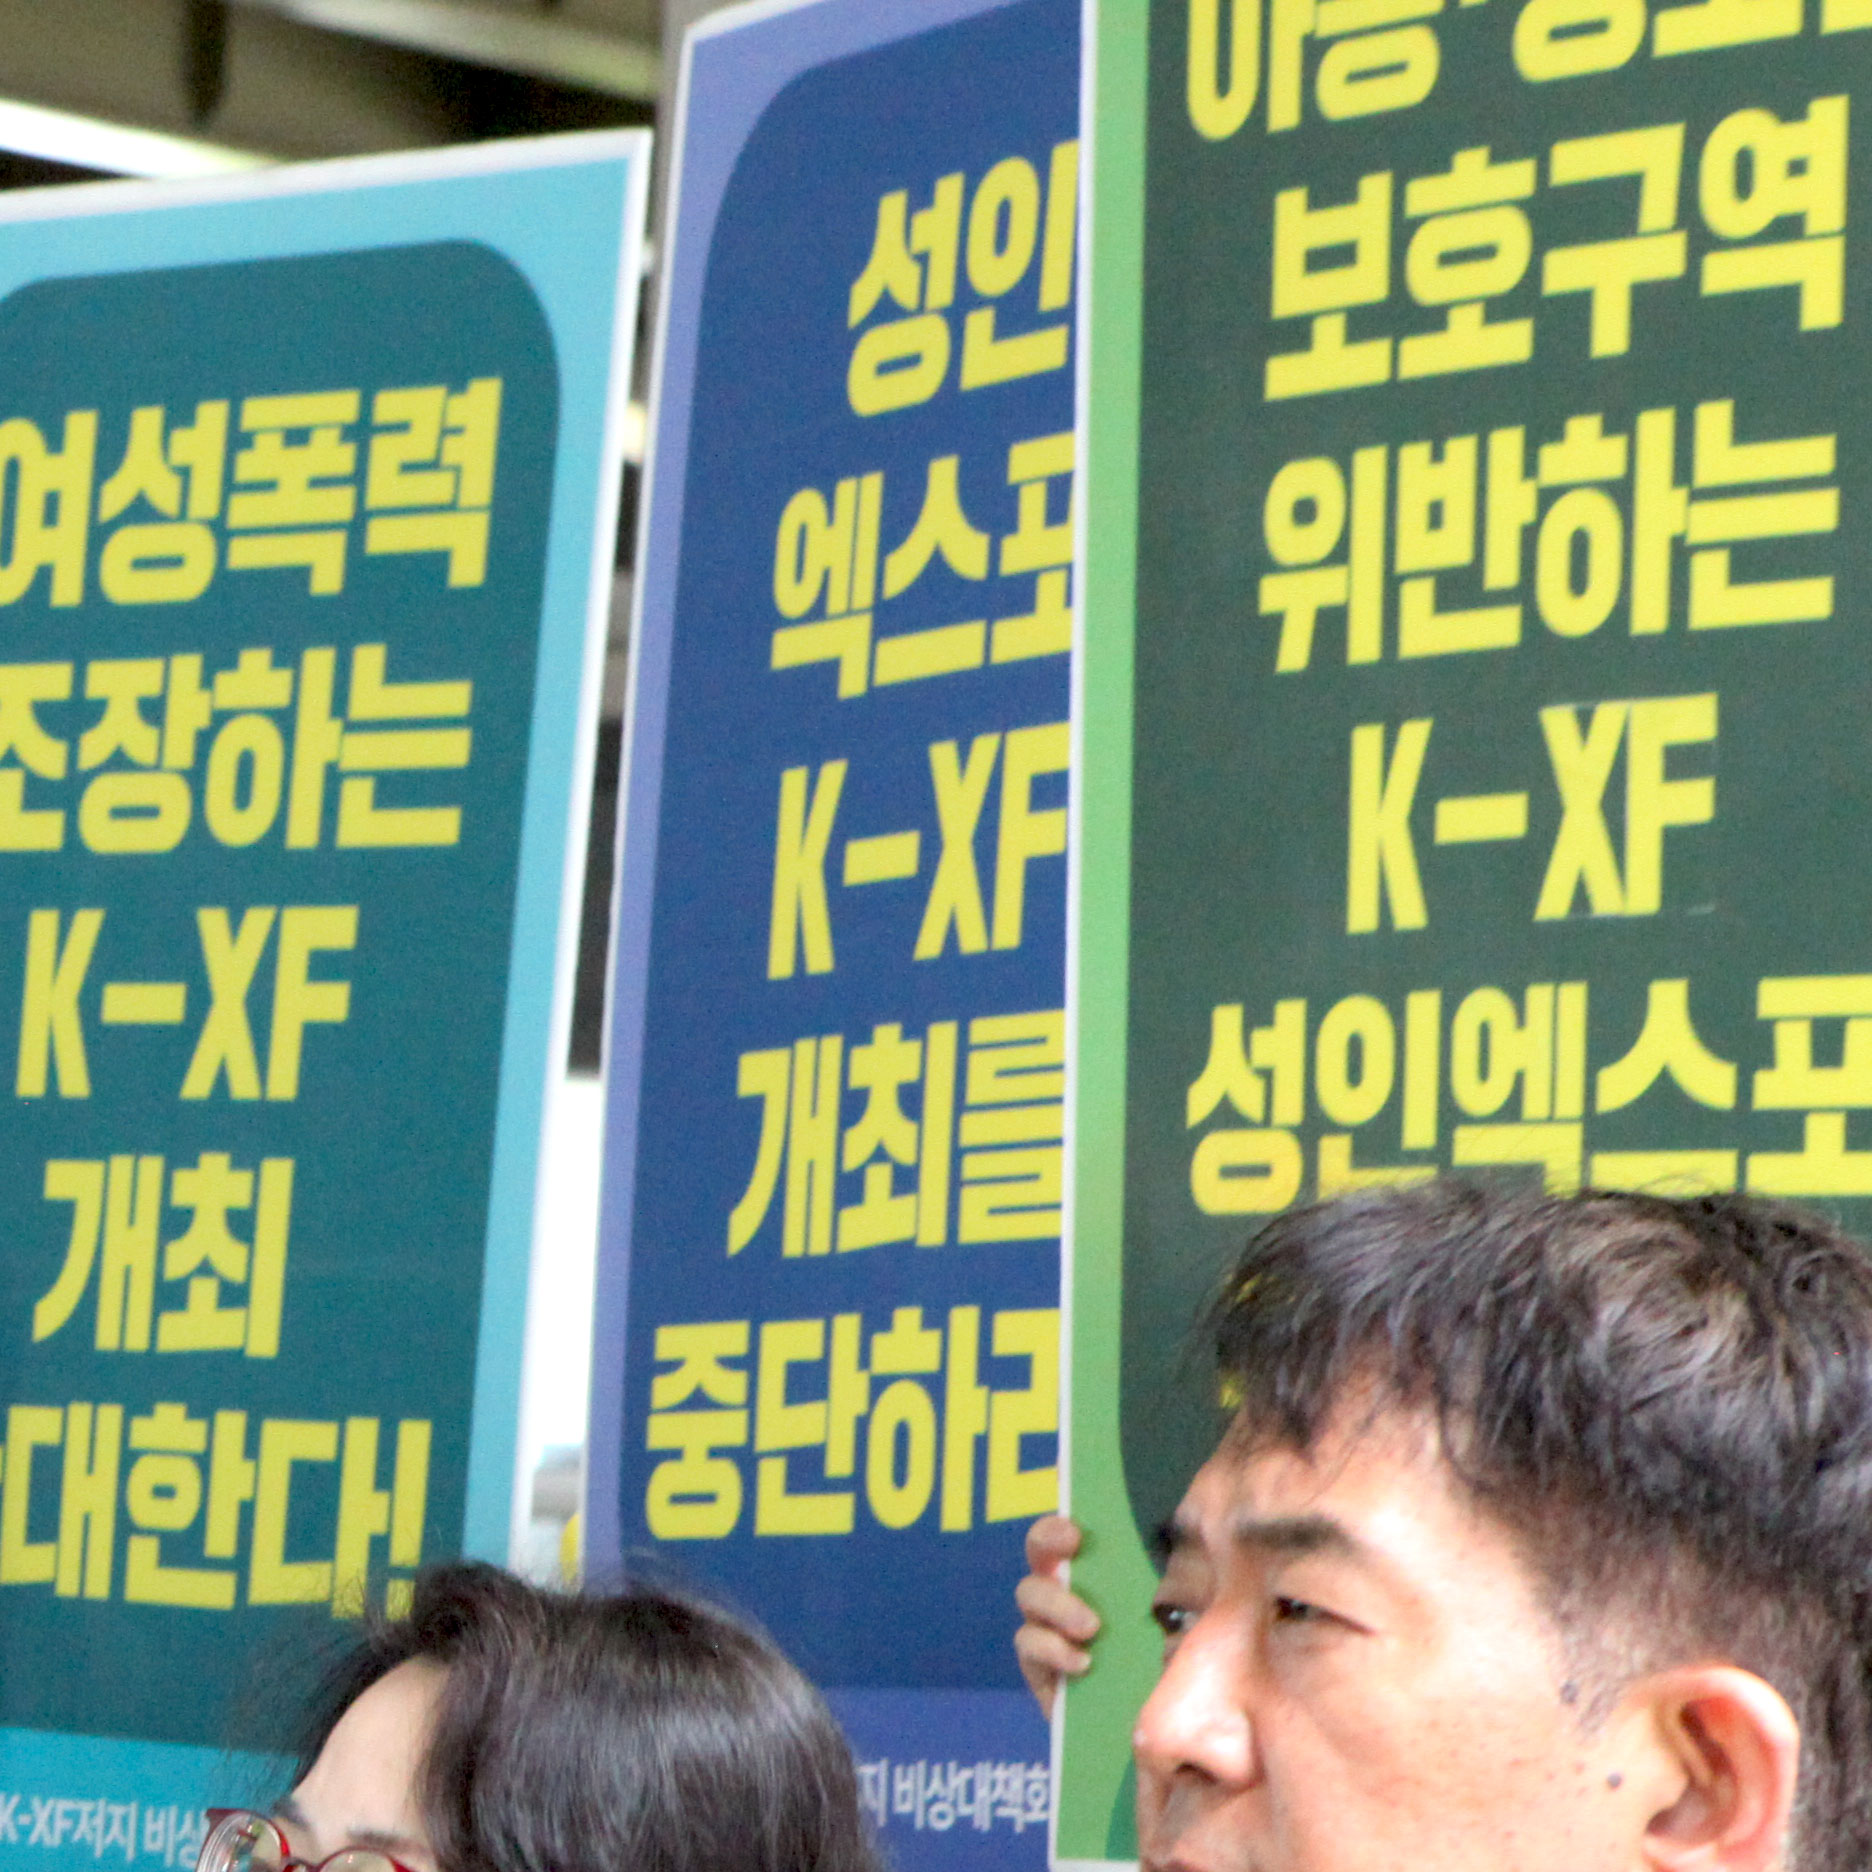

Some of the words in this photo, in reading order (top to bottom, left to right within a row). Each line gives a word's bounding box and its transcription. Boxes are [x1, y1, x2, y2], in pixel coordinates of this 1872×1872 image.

[847, 137, 1079, 418] 성인
[1264, 94, 1850, 401] 보호구역
[1257, 398, 1840, 673] 위반하는
[767, 720, 1071, 980] K-XF
[1346, 692, 1719, 935] K-XF
[14, 905, 360, 1101] K-XF
[1187, 974, 1872, 1216] 성인엑스포
[32, 1152, 295, 1358] 개최
[727, 1009, 1064, 1258] 개최를
